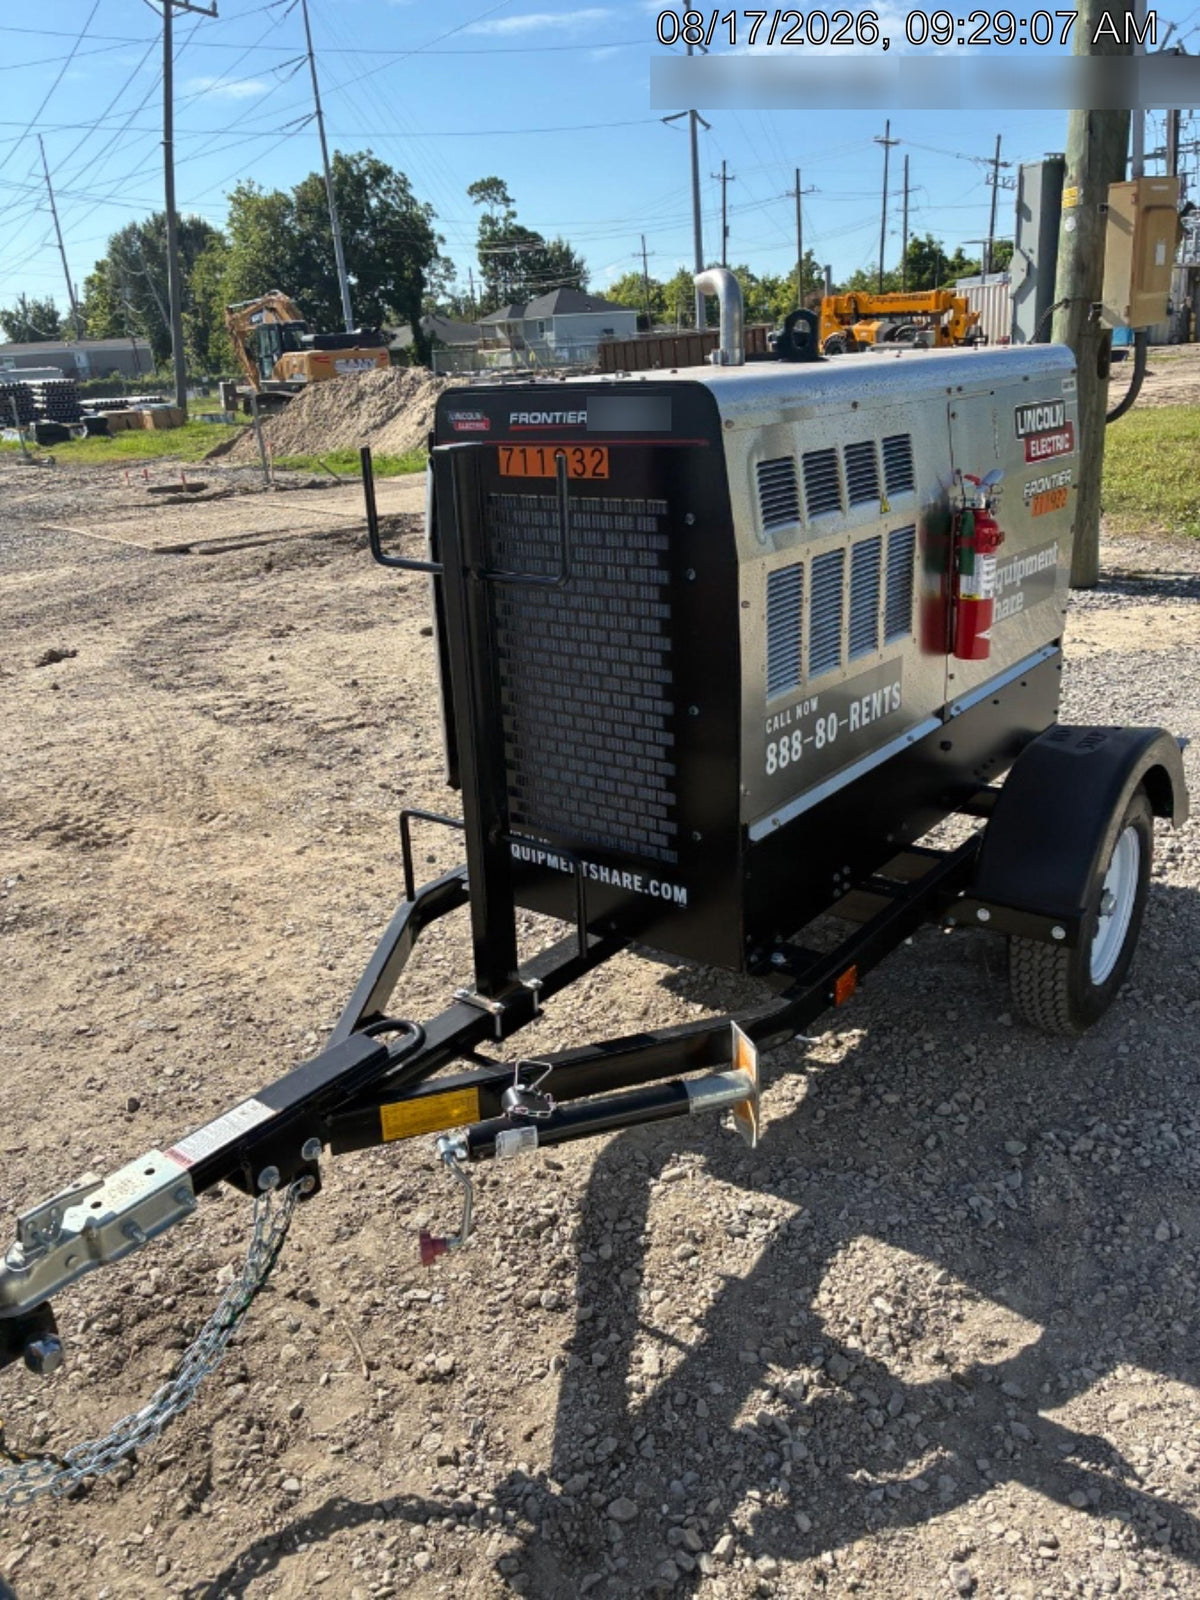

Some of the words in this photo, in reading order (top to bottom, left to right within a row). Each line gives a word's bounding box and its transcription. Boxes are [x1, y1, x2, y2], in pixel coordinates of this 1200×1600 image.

[509, 410, 588, 424] FRONTIER
[1017, 404, 1064, 434] LINCOLN
[1030, 433, 1070, 458] ELECTRIC
[1024, 468, 1072, 500] FRONTIER
[995, 540, 1059, 595] quipment
[993, 591, 1024, 623] hare
[765, 710, 792, 734] CALL
[795, 695, 819, 719] NOW
[765, 681, 901, 776] 888-80-RENTS
[510, 843, 688, 905] QUIPMETSHARE.COM
